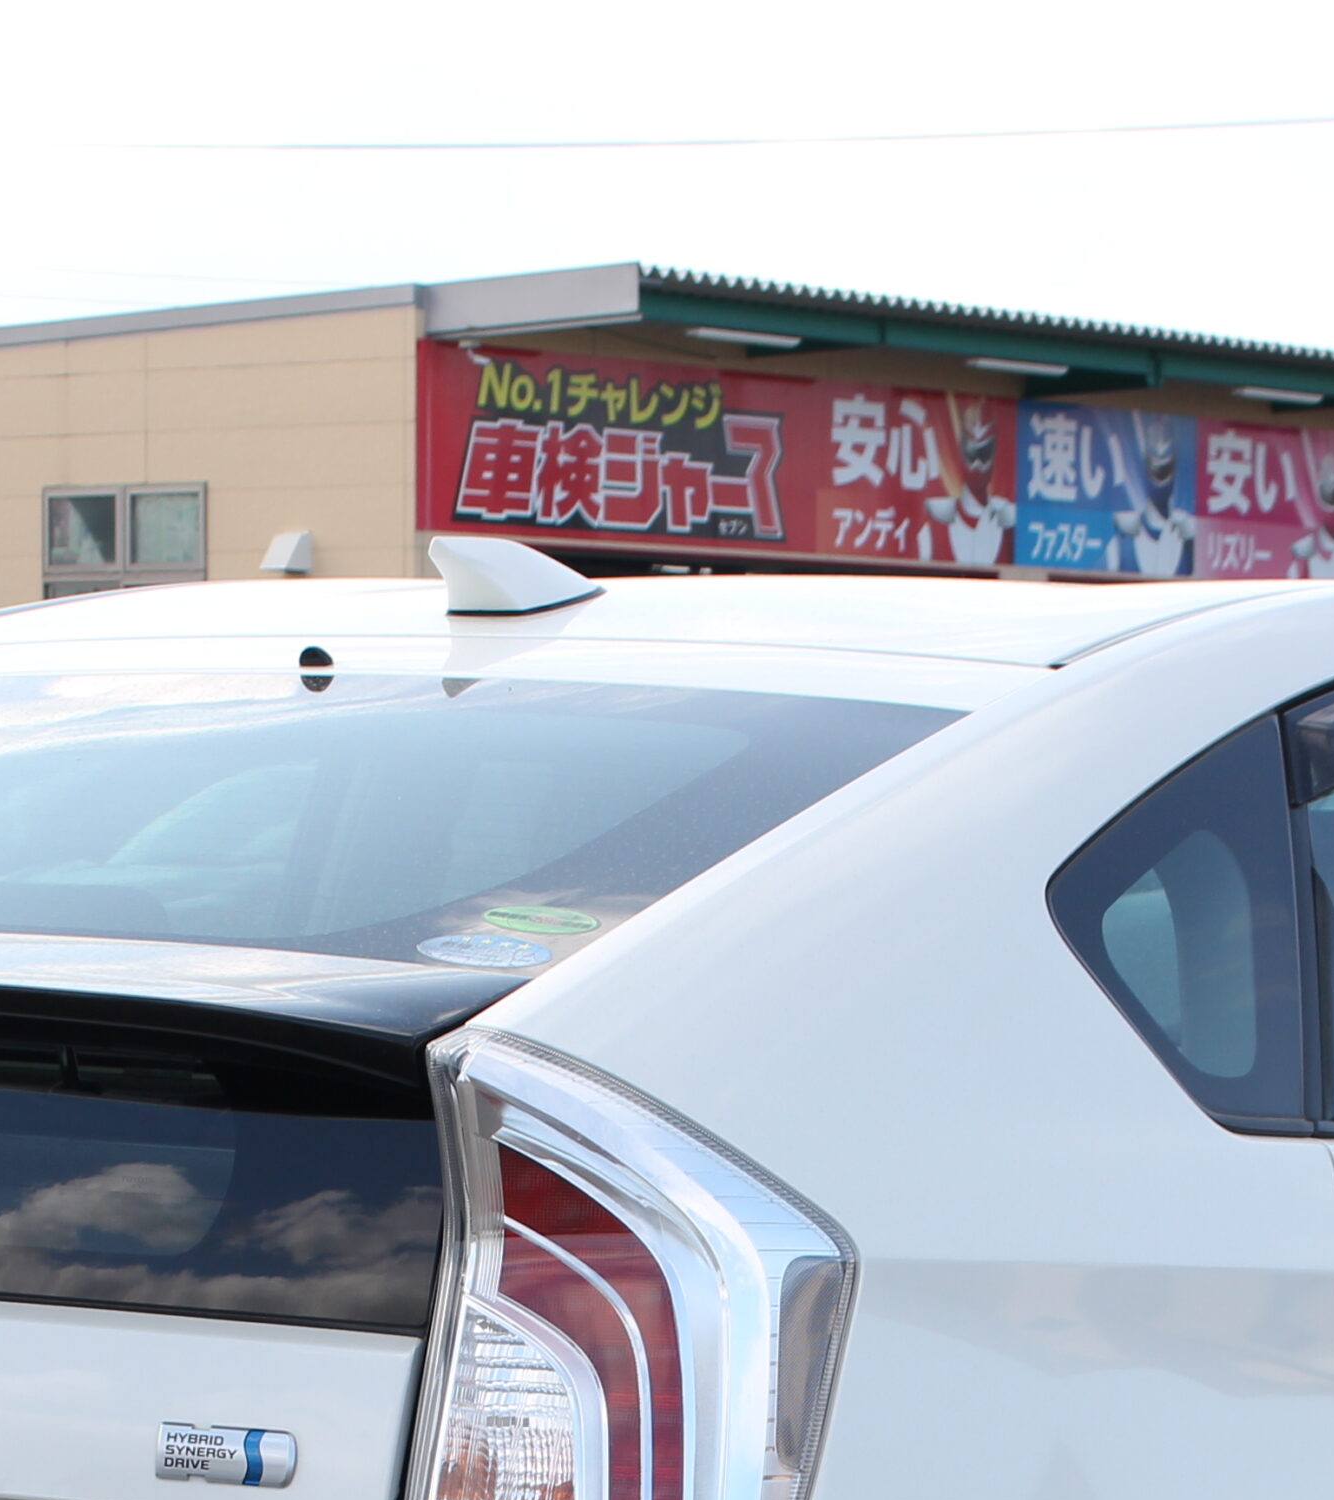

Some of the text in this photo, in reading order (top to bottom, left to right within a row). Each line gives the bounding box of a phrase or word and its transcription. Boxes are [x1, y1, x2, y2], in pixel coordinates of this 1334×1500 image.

[477, 362, 723, 429] No.1チャレンジ
[831, 394, 938, 491] 安心
[1028, 412, 1125, 501] 速い
[1207, 428, 1298, 515] 安い
[1028, 520, 1103, 562] ファスター
[164, 1457, 210, 1470] DRIVE
[165, 1444, 237, 1460] SYNERGY
[166, 1432, 224, 1446] HYBRID
